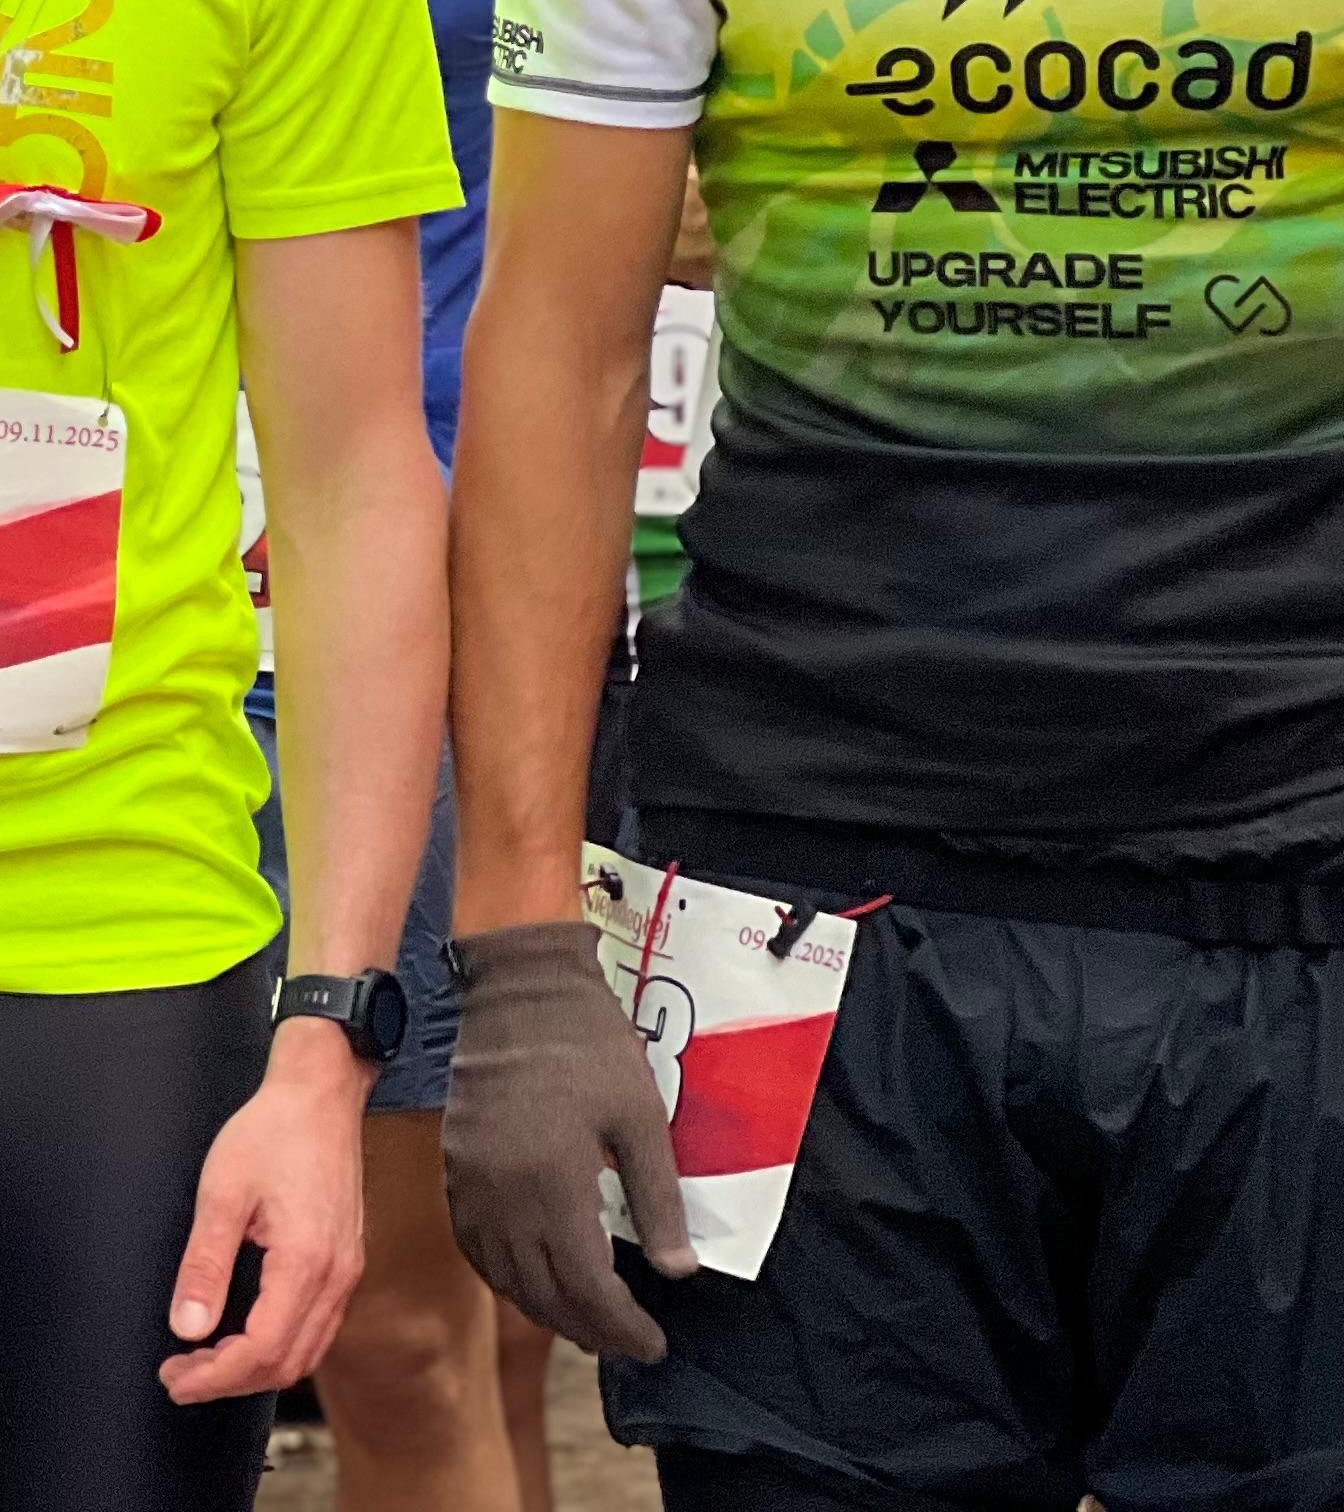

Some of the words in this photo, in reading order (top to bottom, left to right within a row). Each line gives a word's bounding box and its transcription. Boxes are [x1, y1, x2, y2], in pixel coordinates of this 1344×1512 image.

[844, 29, 1313, 117] ecocad
[1012, 144, 1289, 182] MITSUBISHI
[1013, 180, 1257, 220] ELECTRIC
[866, 250, 1145, 290] UPGRADE
[871, 298, 1172, 340] YOURSELF
[738, 925, 846, 973] 09..2025
